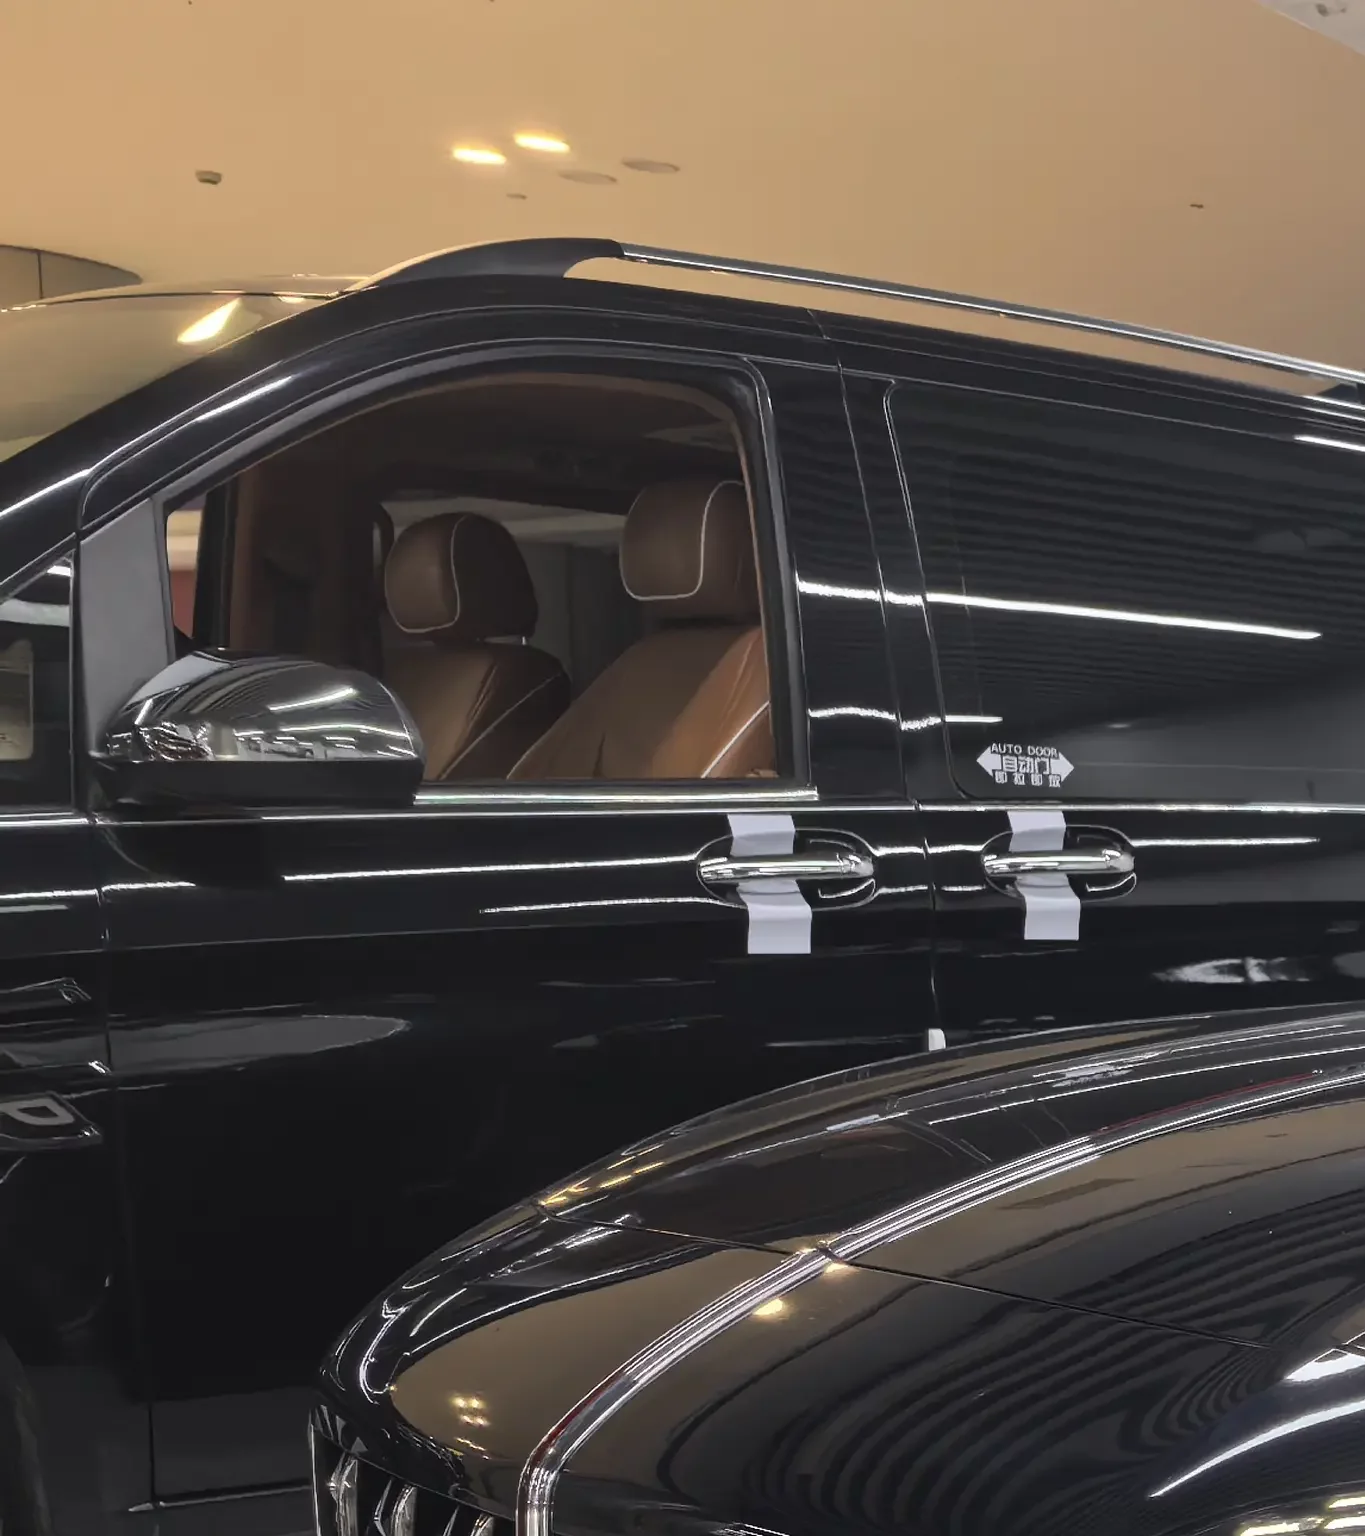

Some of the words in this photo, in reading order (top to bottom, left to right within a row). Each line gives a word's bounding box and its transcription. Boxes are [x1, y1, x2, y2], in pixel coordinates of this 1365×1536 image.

[991, 743, 1022, 754] AUTO
[1027, 745, 1058, 758] DOOR
[1002, 755, 1049, 774] 自动门
